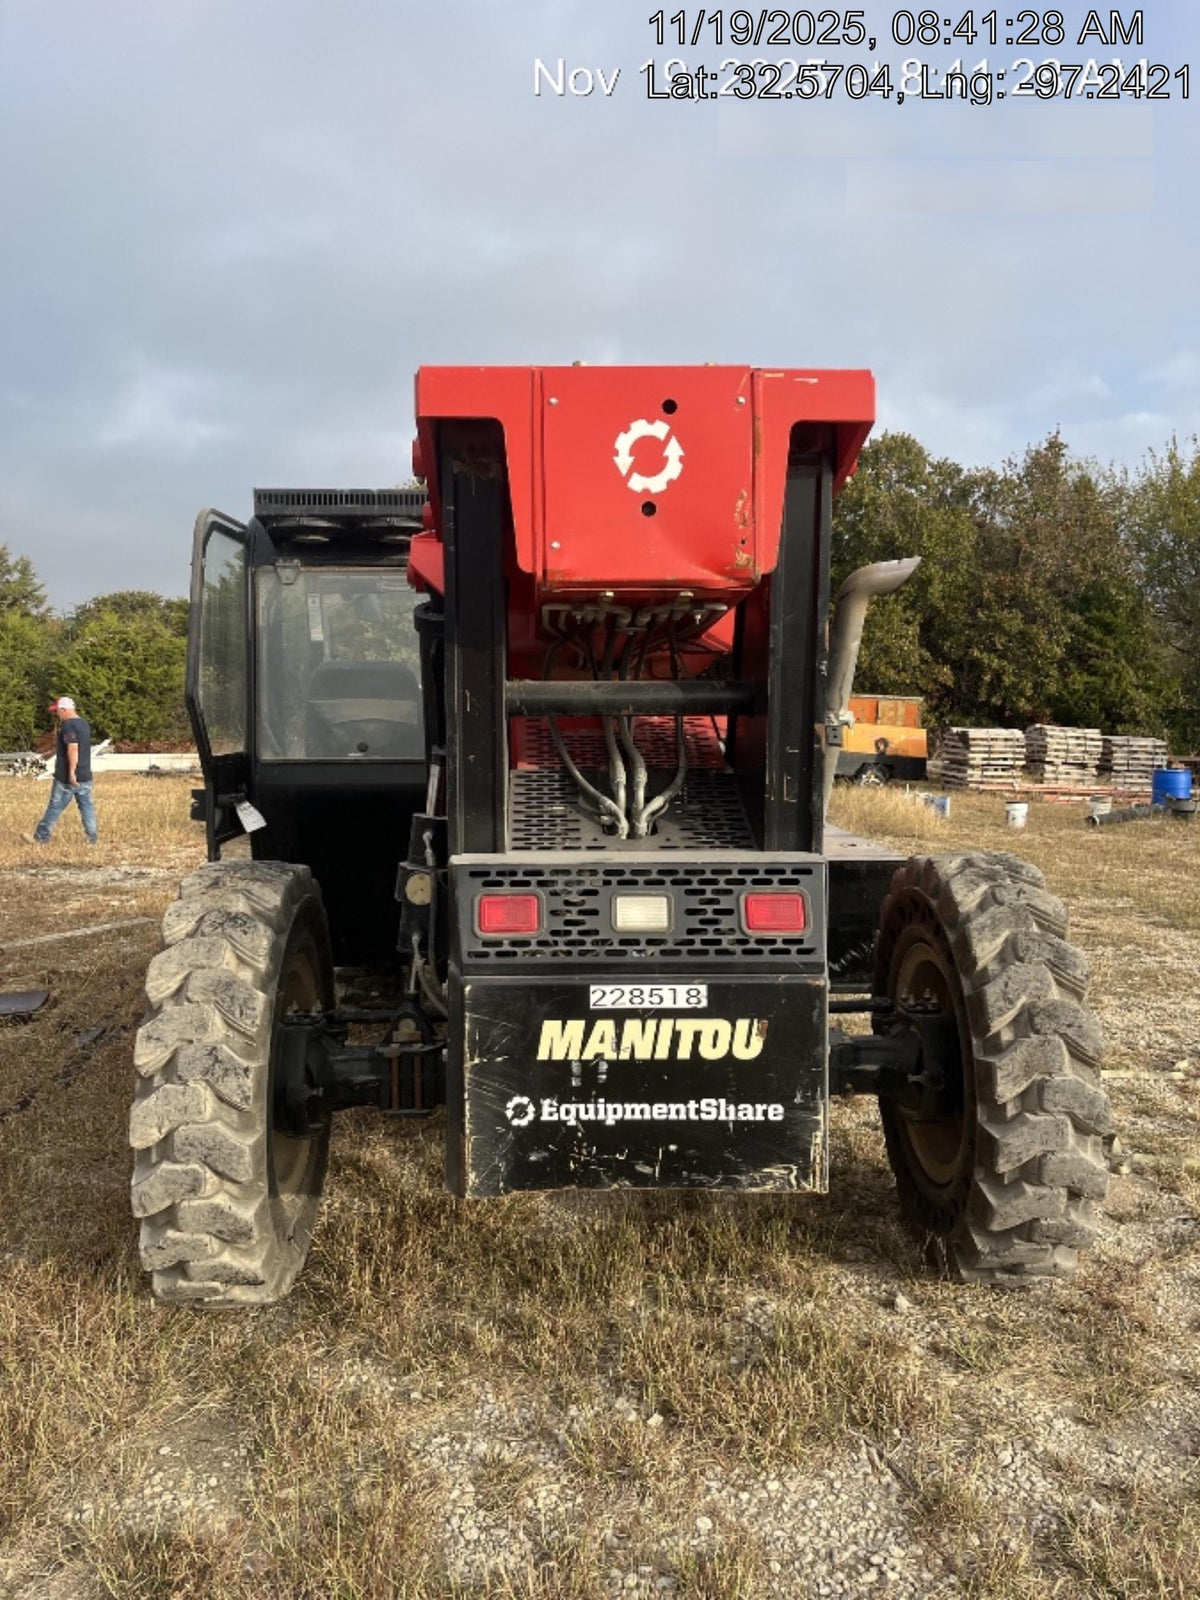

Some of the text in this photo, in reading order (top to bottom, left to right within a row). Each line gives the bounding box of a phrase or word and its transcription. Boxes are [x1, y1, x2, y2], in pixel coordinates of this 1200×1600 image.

[591, 987, 702, 1007] 228518
[537, 1018, 769, 1060] MANITOU
[540, 1098, 784, 1125] EquipmentShare
